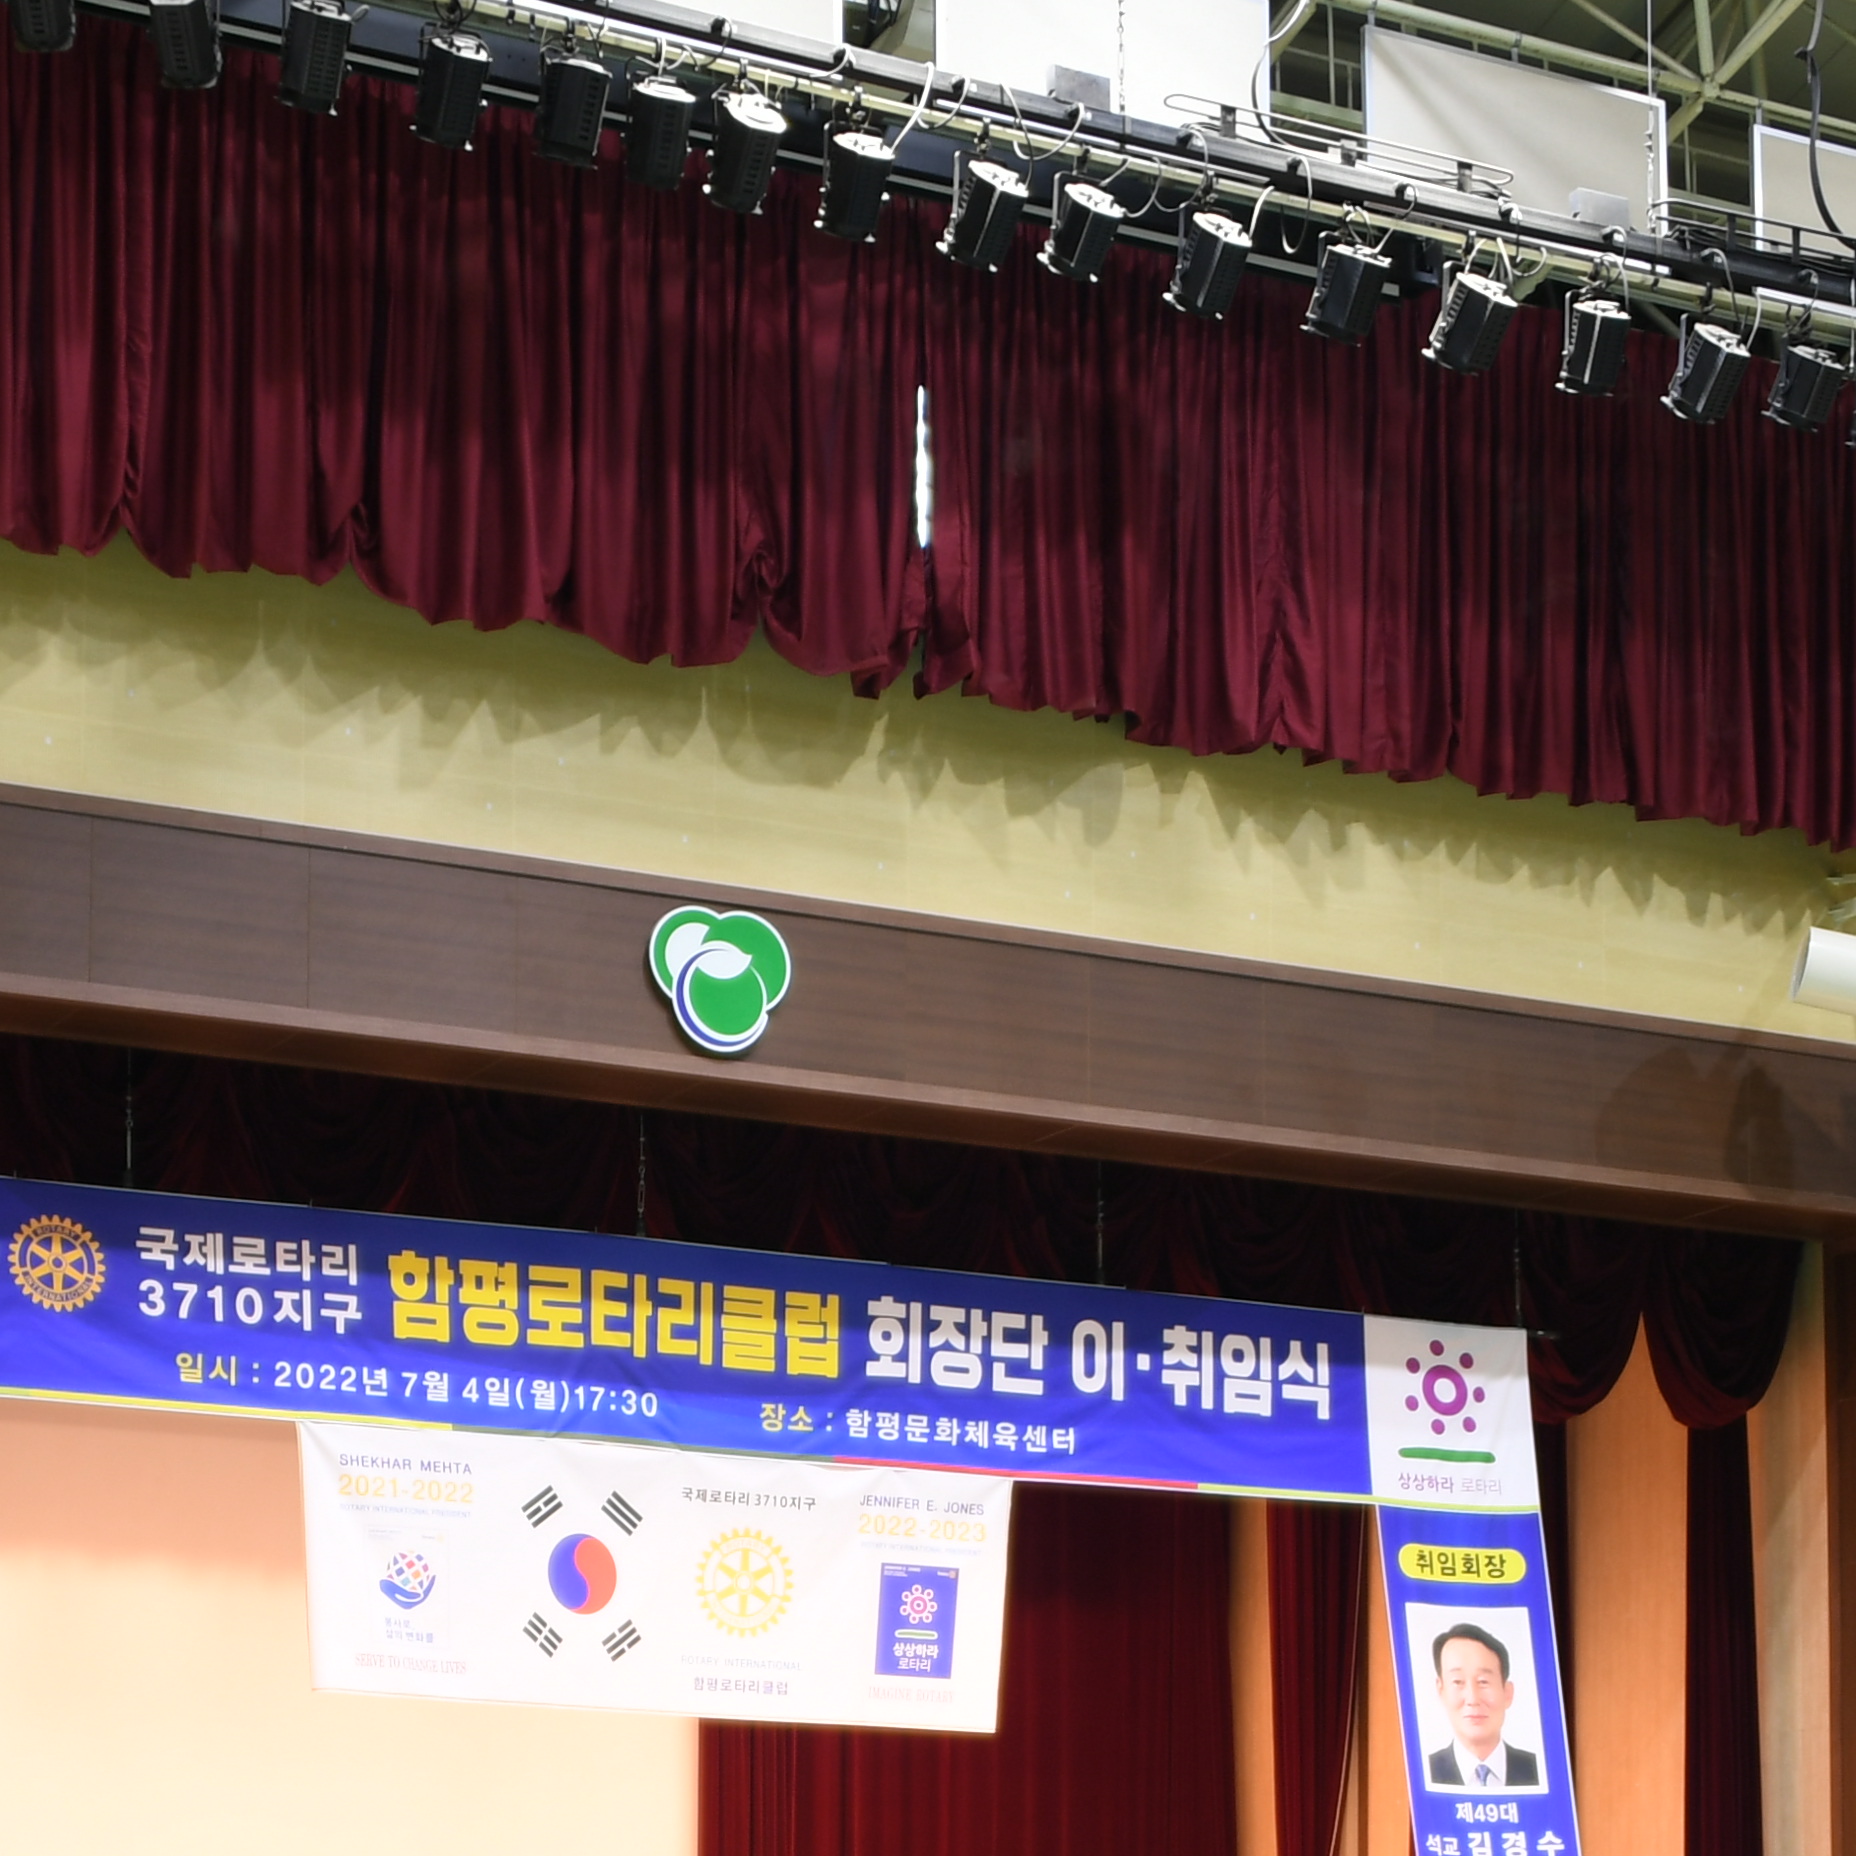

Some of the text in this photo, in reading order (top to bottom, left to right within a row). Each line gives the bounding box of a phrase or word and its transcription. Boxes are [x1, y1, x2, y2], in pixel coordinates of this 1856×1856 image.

[34, 1225, 77, 1239] ROTARY
[136, 1225, 358, 1287] 국제로타리
[138, 1277, 363, 1335] 3710지구
[388, 1250, 1331, 1420] 함평로타리클럽 회장단 이·취임식
[175, 1352, 239, 1386] 일시
[274, 1360, 389, 1398] 2022년
[401, 1371, 449, 1403] 7월
[759, 1403, 813, 1431] 장소
[845, 1407, 1076, 1455] 함평문화체육센터
[339, 1453, 473, 1475] SHEKHAR MEHTA
[337, 1473, 474, 1503] 2021-2022
[1398, 1472, 1503, 1495] 상상하라 로타리
[681, 1487, 817, 1511] 국제로타리 3710지구
[859, 1494, 920, 1510] JENNIFER
[943, 1501, 985, 1516] JONES
[858, 1513, 987, 1543] 2022-2023
[1415, 1549, 1506, 1579] 취임회장
[893, 1642, 939, 1659] 상상하라
[898, 1658, 931, 1673] 로타리
[693, 1676, 789, 1696] 함평로타리클럽
[1455, 1801, 1520, 1824] 제49대
[1425, 1833, 1461, 1856] 석교
